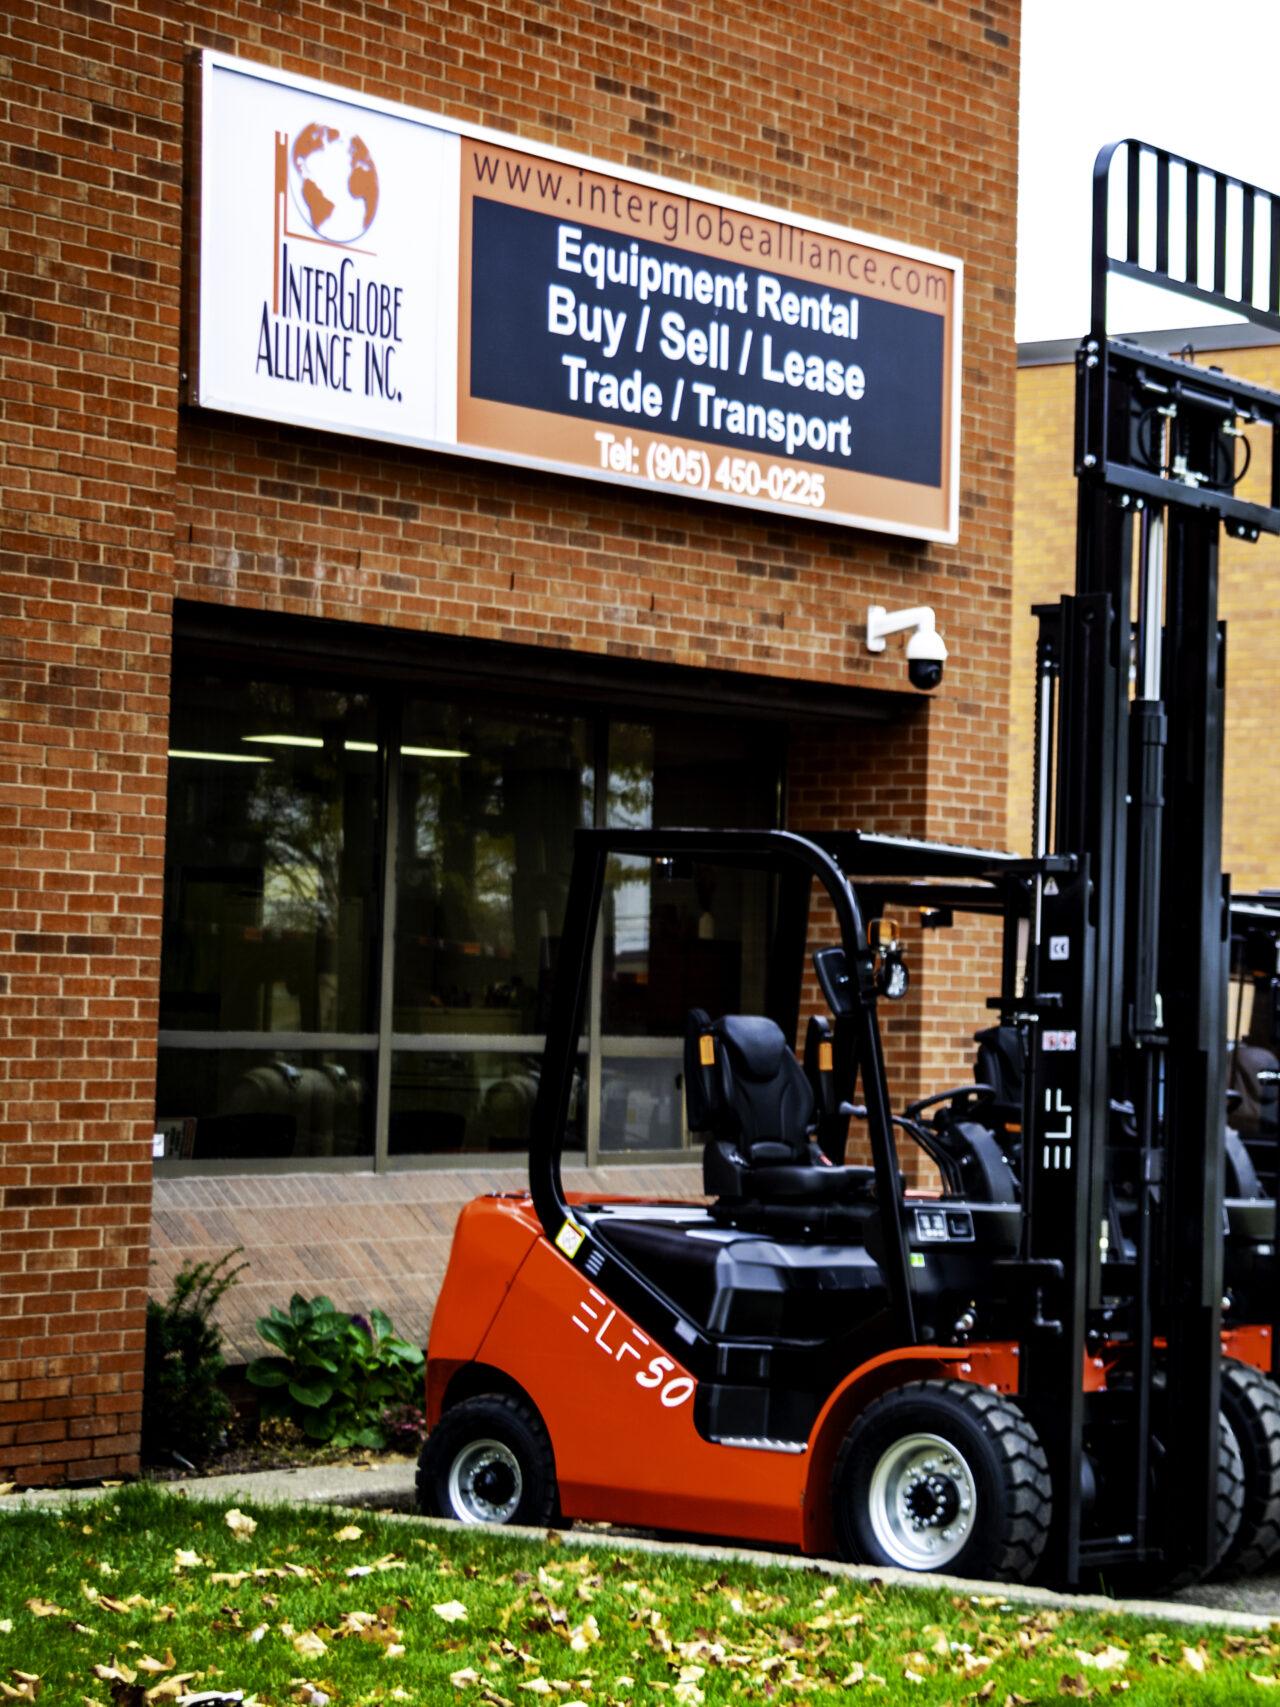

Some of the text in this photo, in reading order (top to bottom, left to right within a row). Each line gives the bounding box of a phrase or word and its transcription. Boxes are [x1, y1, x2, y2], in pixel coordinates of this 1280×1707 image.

[473, 152, 947, 302] www.interglobealliance.com
[556, 223, 859, 340] Equipment Rental
[547, 283, 627, 358] Buy
[659, 310, 730, 371] Sell
[762, 333, 866, 400] Lease
[561, 353, 663, 417] Trade
[692, 382, 852, 456] Transport
[594, 431, 826, 508] Tel: (905) 450-0225
[1043, 1087, 1072, 1170] ELF
